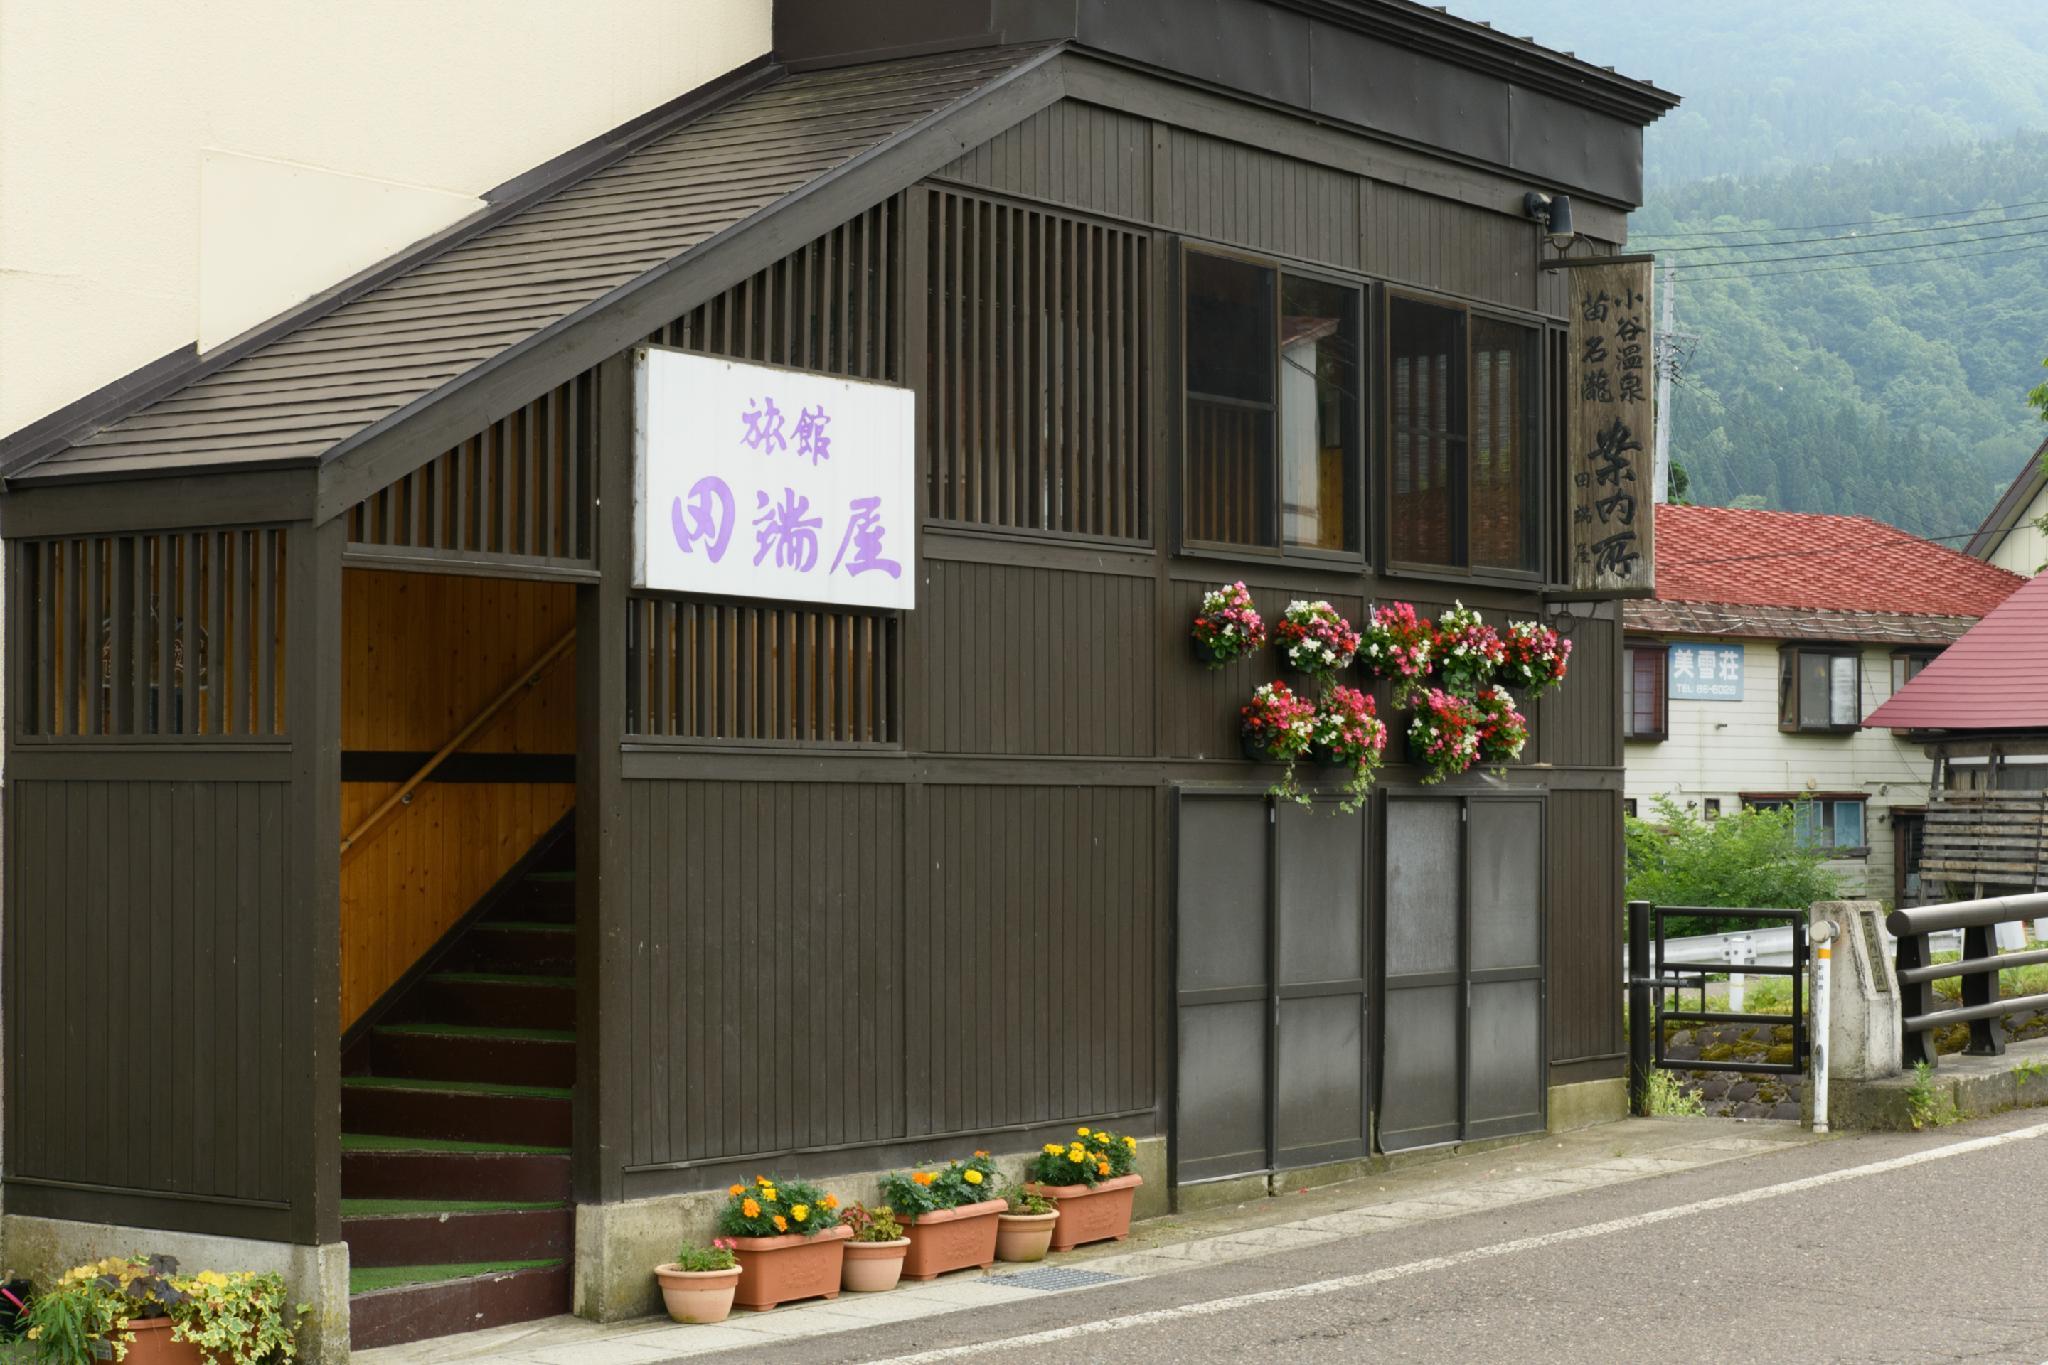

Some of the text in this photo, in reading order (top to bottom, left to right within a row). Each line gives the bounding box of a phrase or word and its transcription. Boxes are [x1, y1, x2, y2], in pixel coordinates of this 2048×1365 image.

[740, 396, 832, 466] 旅館
[671, 475, 902, 580] 田端屋
[1574, 472, 1592, 563] 田端屋
[1588, 415, 1643, 578] 案内所
[1673, 648, 1739, 681] 美雪荘
[1676, 683, 1693, 694] TEL
